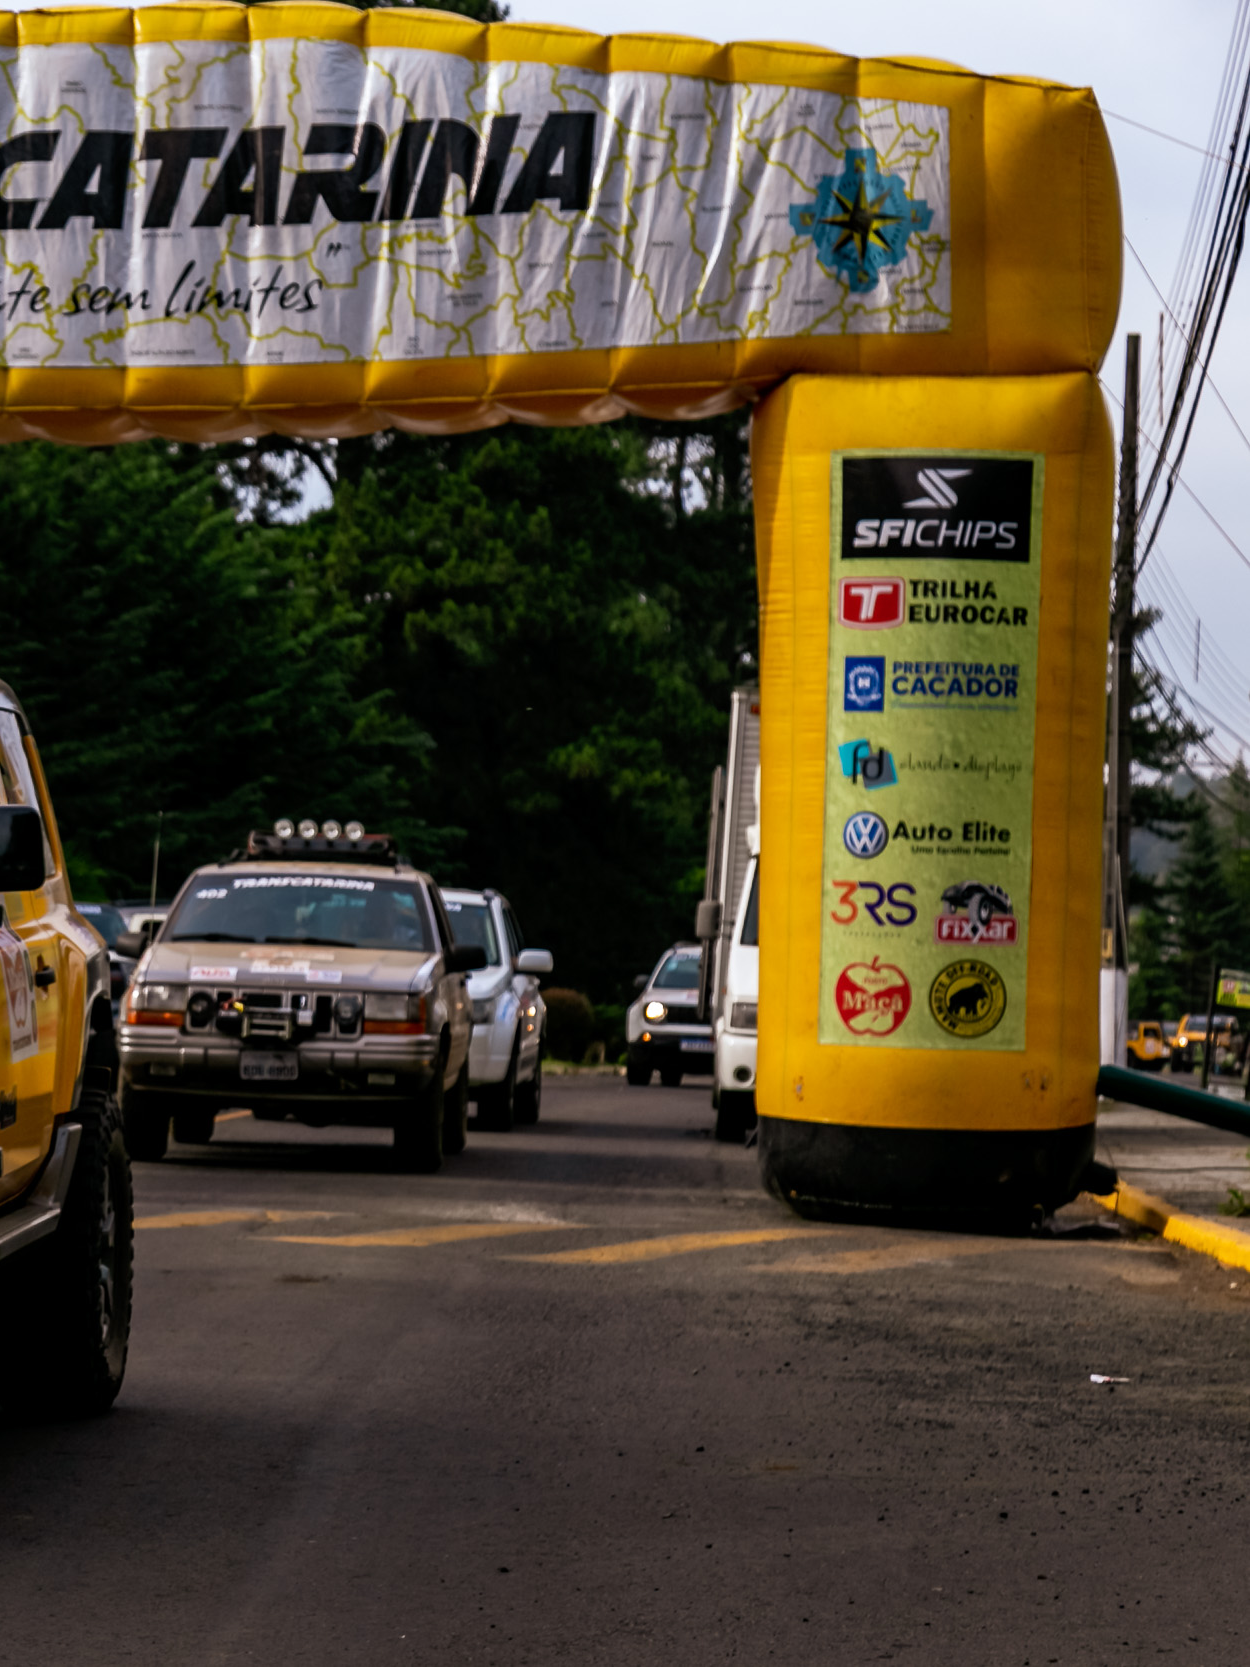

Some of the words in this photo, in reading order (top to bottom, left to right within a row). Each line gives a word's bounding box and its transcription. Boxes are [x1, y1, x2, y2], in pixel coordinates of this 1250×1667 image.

[62, 281, 152, 317] sem
[853, 519, 1018, 549] SFICHIPS
[909, 580, 997, 599] TRILHA
[909, 604, 1028, 626] EUROCAR
[893, 661, 996, 676] PREFEITURA
[1000, 664, 1020, 677] DE
[892, 677, 1018, 699] CAÇADOR
[893, 821, 953, 842] Auto
[962, 822, 1011, 843] Elite
[831, 880, 918, 927] 3RS
